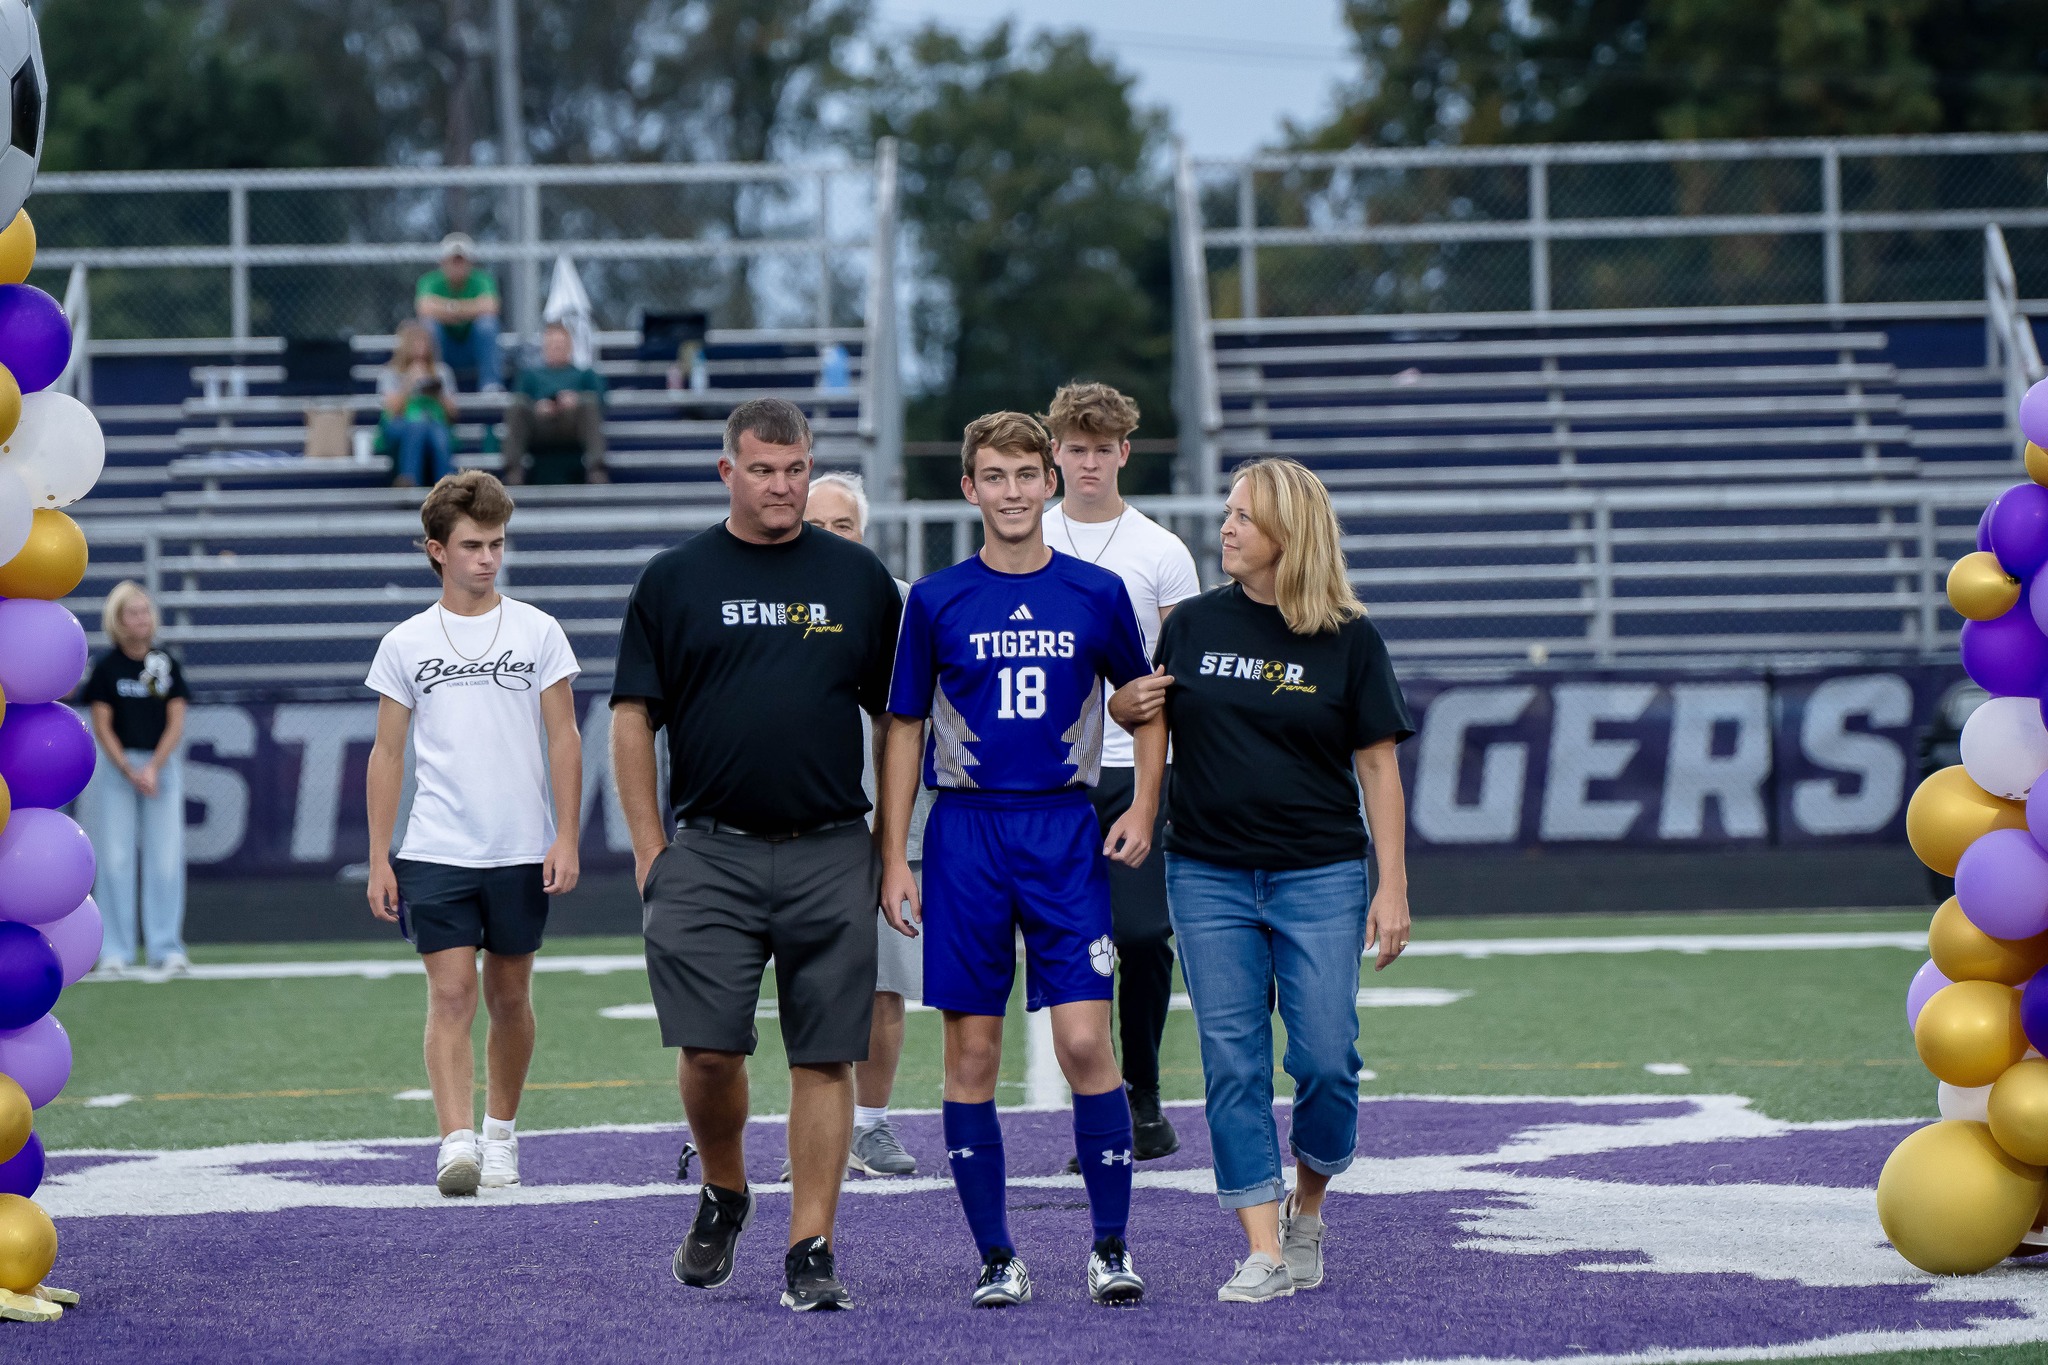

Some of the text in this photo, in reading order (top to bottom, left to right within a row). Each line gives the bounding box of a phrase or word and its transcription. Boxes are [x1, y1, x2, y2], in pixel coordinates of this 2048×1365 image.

[803, 619, 843, 639] Farrell
[970, 631, 1074, 659] TIGERS
[415, 650, 536, 694] Beaches
[1271, 679, 1317, 695] Farrell
[998, 667, 1045, 718] 18
[1405, 674, 1914, 843] GERS
